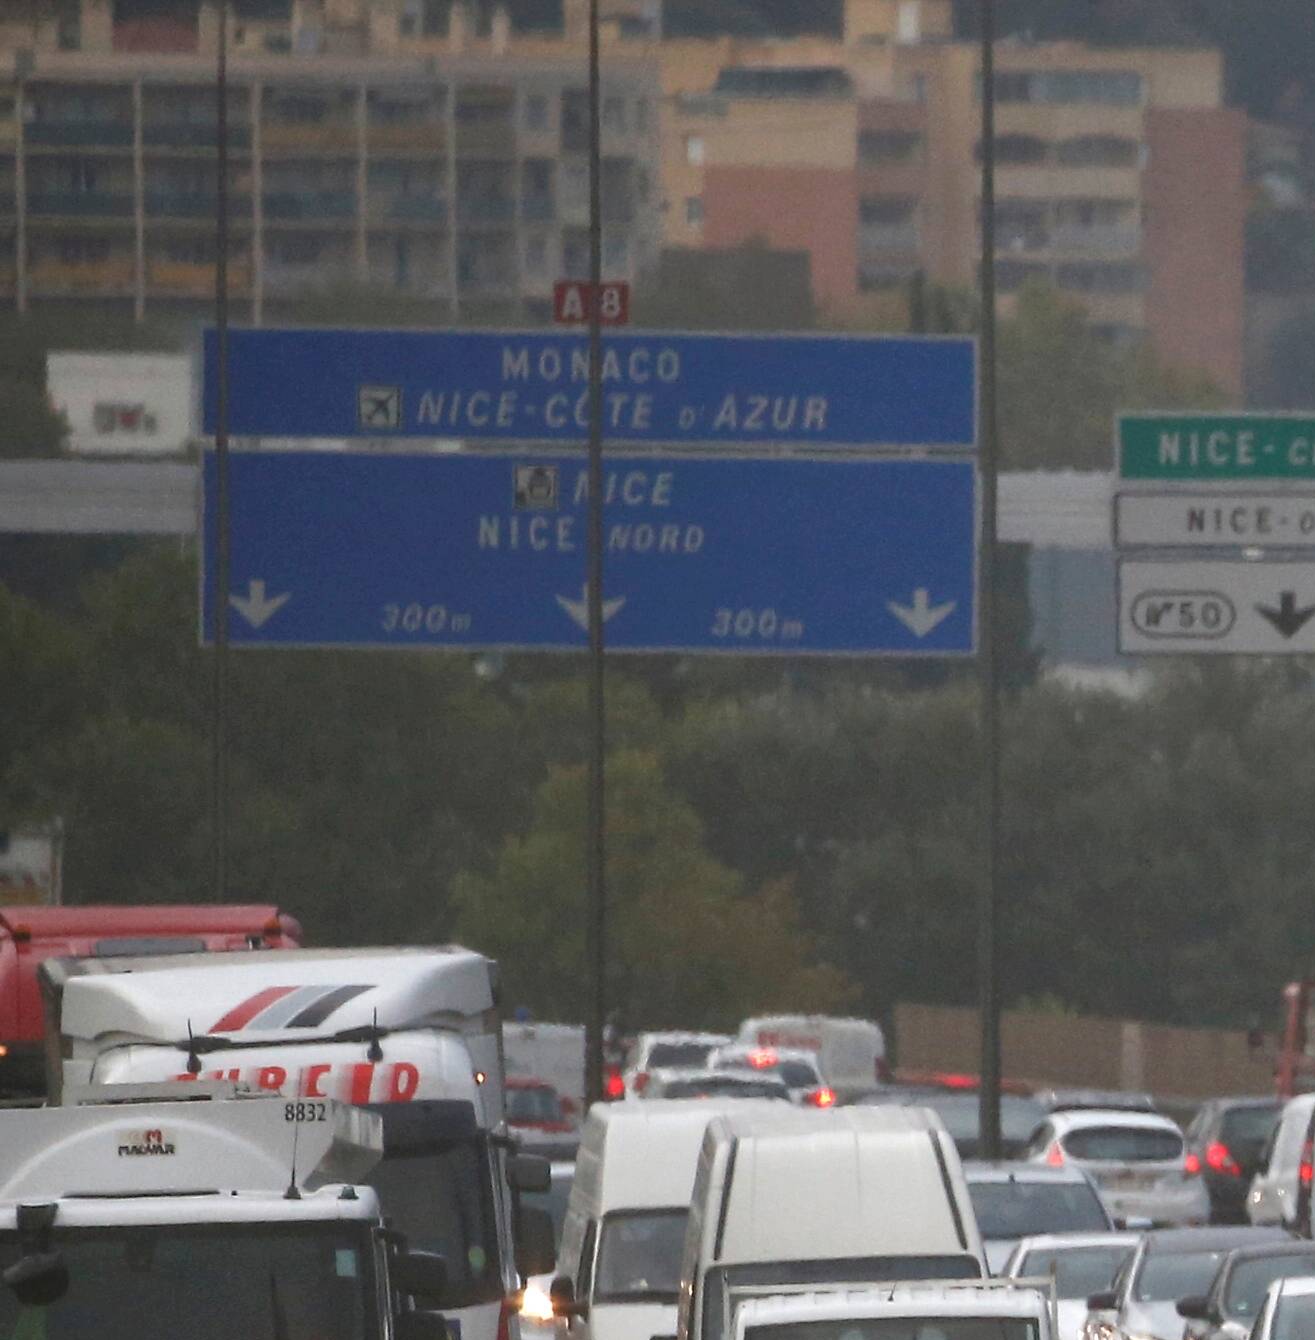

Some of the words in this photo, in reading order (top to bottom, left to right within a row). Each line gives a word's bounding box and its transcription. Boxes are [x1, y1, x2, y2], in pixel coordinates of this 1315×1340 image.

[561, 289, 584, 319] A
[600, 289, 622, 319] 8
[502, 346, 682, 382] MONACO
[713, 395, 829, 431] AZUR
[478, 516, 576, 551] NICE
[608, 524, 705, 553] NORD
[284, 1103, 327, 1122] 8832
